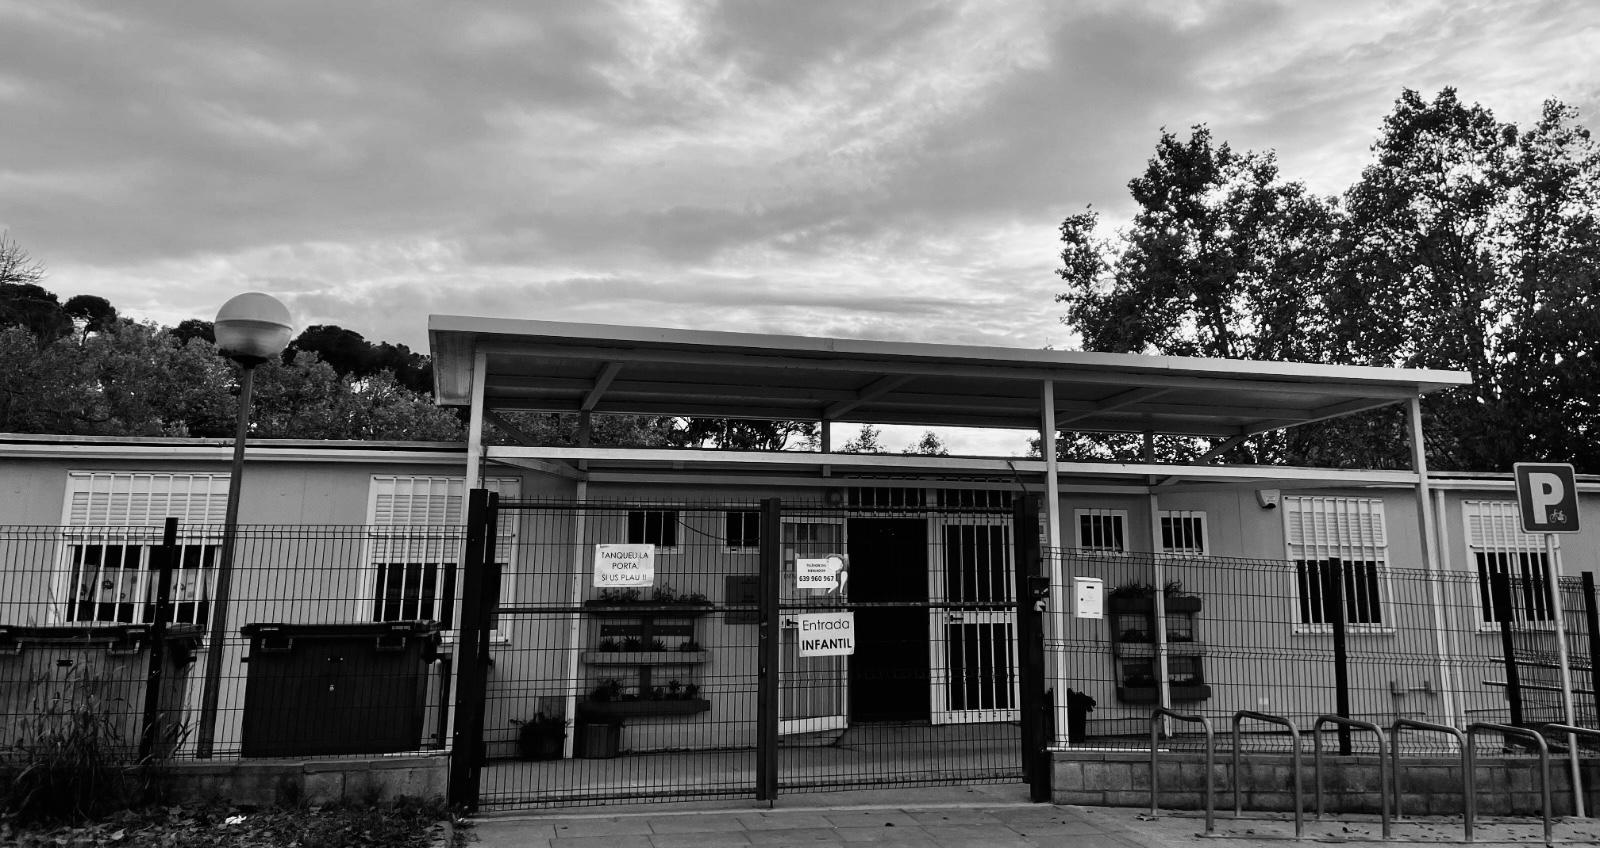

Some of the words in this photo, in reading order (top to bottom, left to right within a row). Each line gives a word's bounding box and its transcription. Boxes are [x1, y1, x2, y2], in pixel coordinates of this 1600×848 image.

[1528, 472, 1565, 525] P
[802, 618, 850, 630] Entrada
[802, 638, 852, 650] INFANTIL
